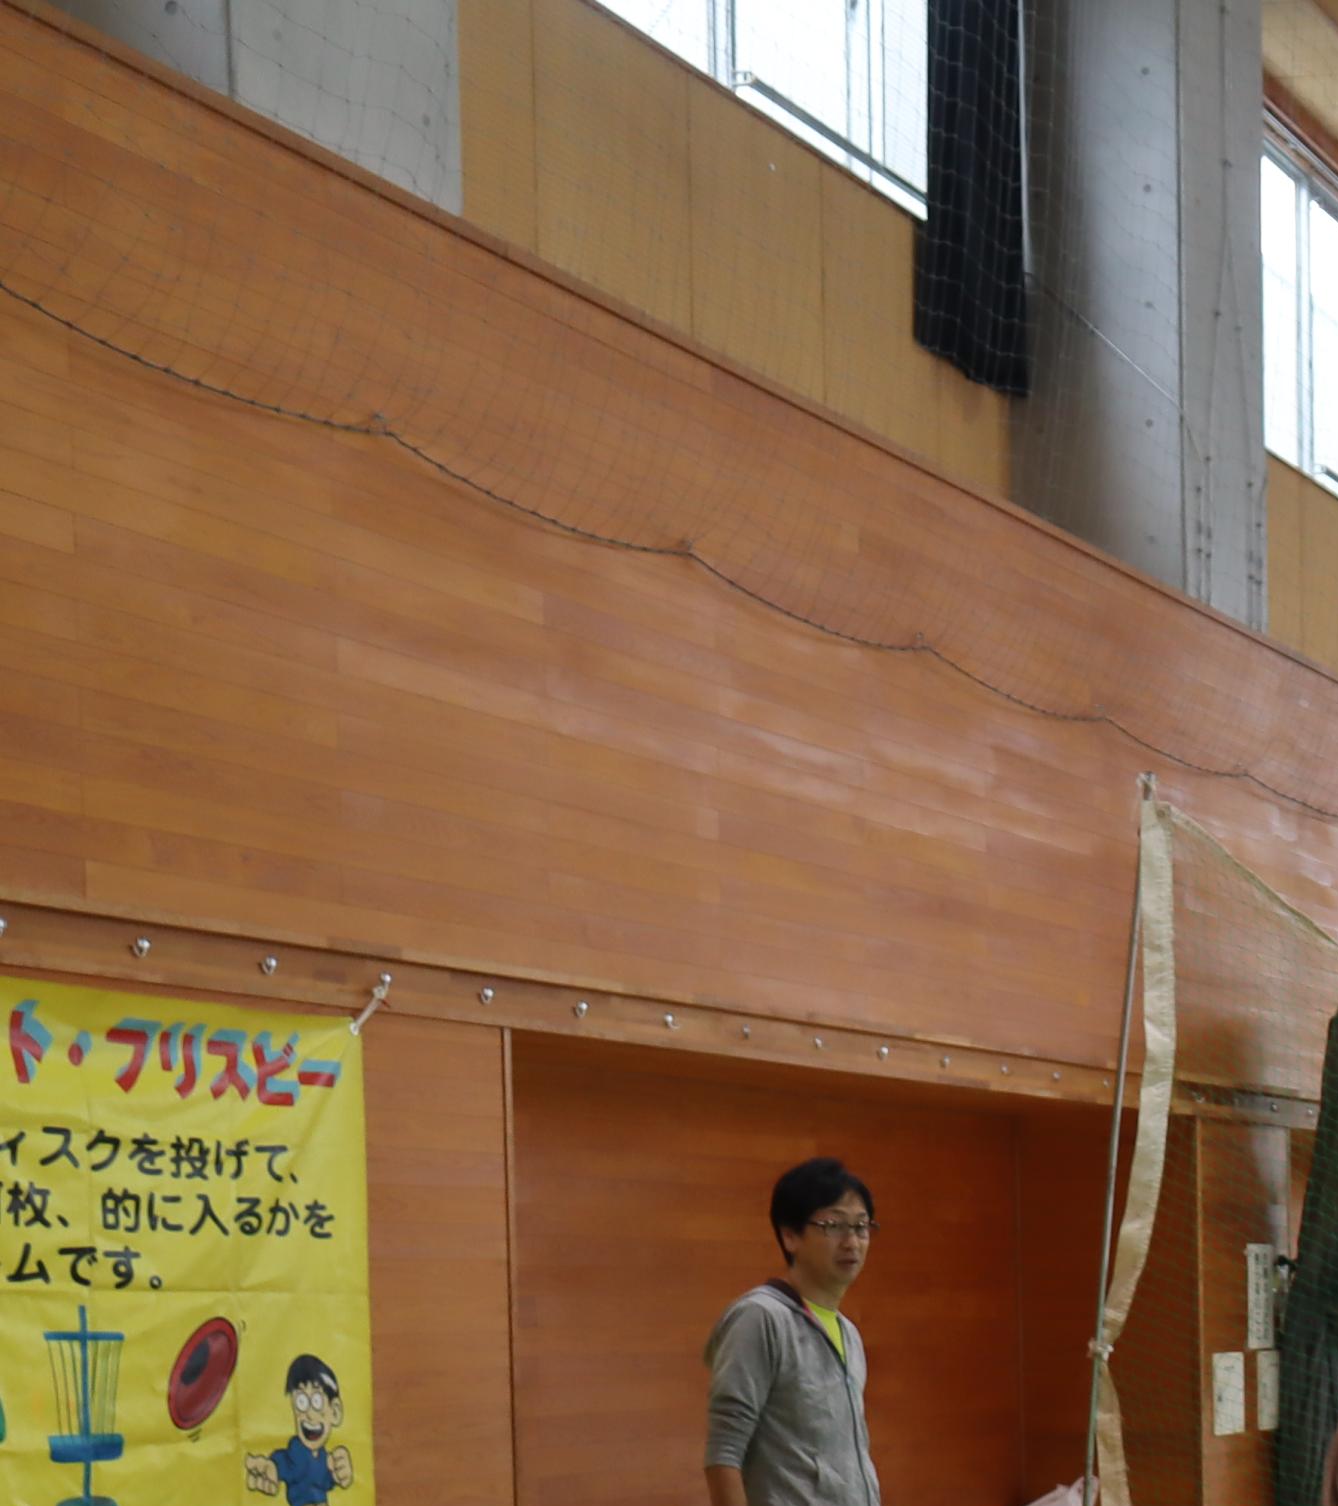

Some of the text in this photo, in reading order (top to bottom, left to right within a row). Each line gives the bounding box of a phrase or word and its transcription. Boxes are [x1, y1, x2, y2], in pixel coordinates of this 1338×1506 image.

[0, 1181, 335, 1239] 枚、的に入るかを
[0, 1243, 162, 1290] ムです。
